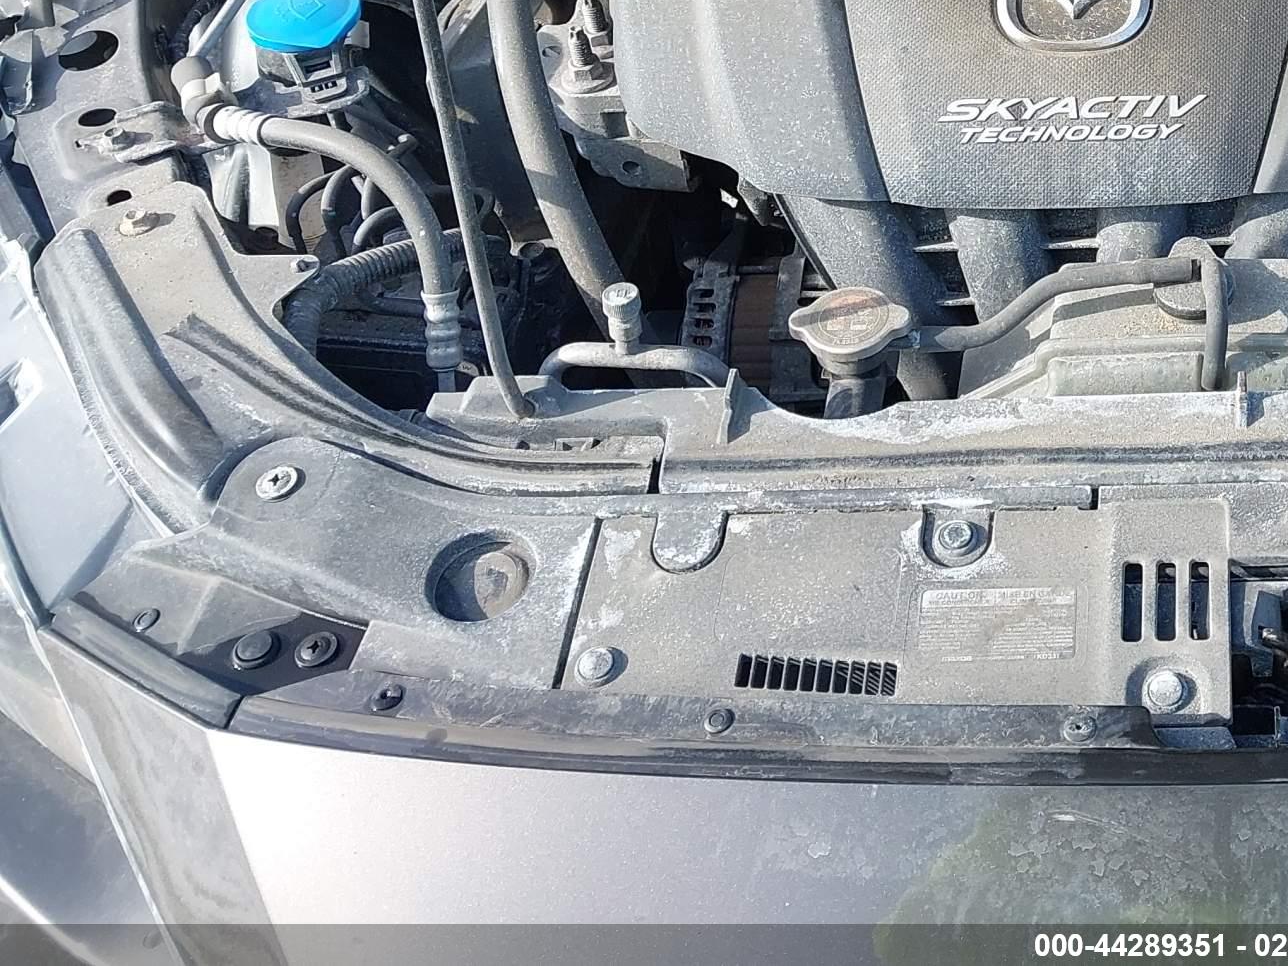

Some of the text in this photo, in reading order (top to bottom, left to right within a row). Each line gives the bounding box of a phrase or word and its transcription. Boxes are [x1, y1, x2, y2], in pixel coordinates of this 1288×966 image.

[937, 94, 1208, 122] SKYACTIV
[960, 123, 1185, 144] TECHNOLOGY
[935, 591, 987, 601] CAUTON
